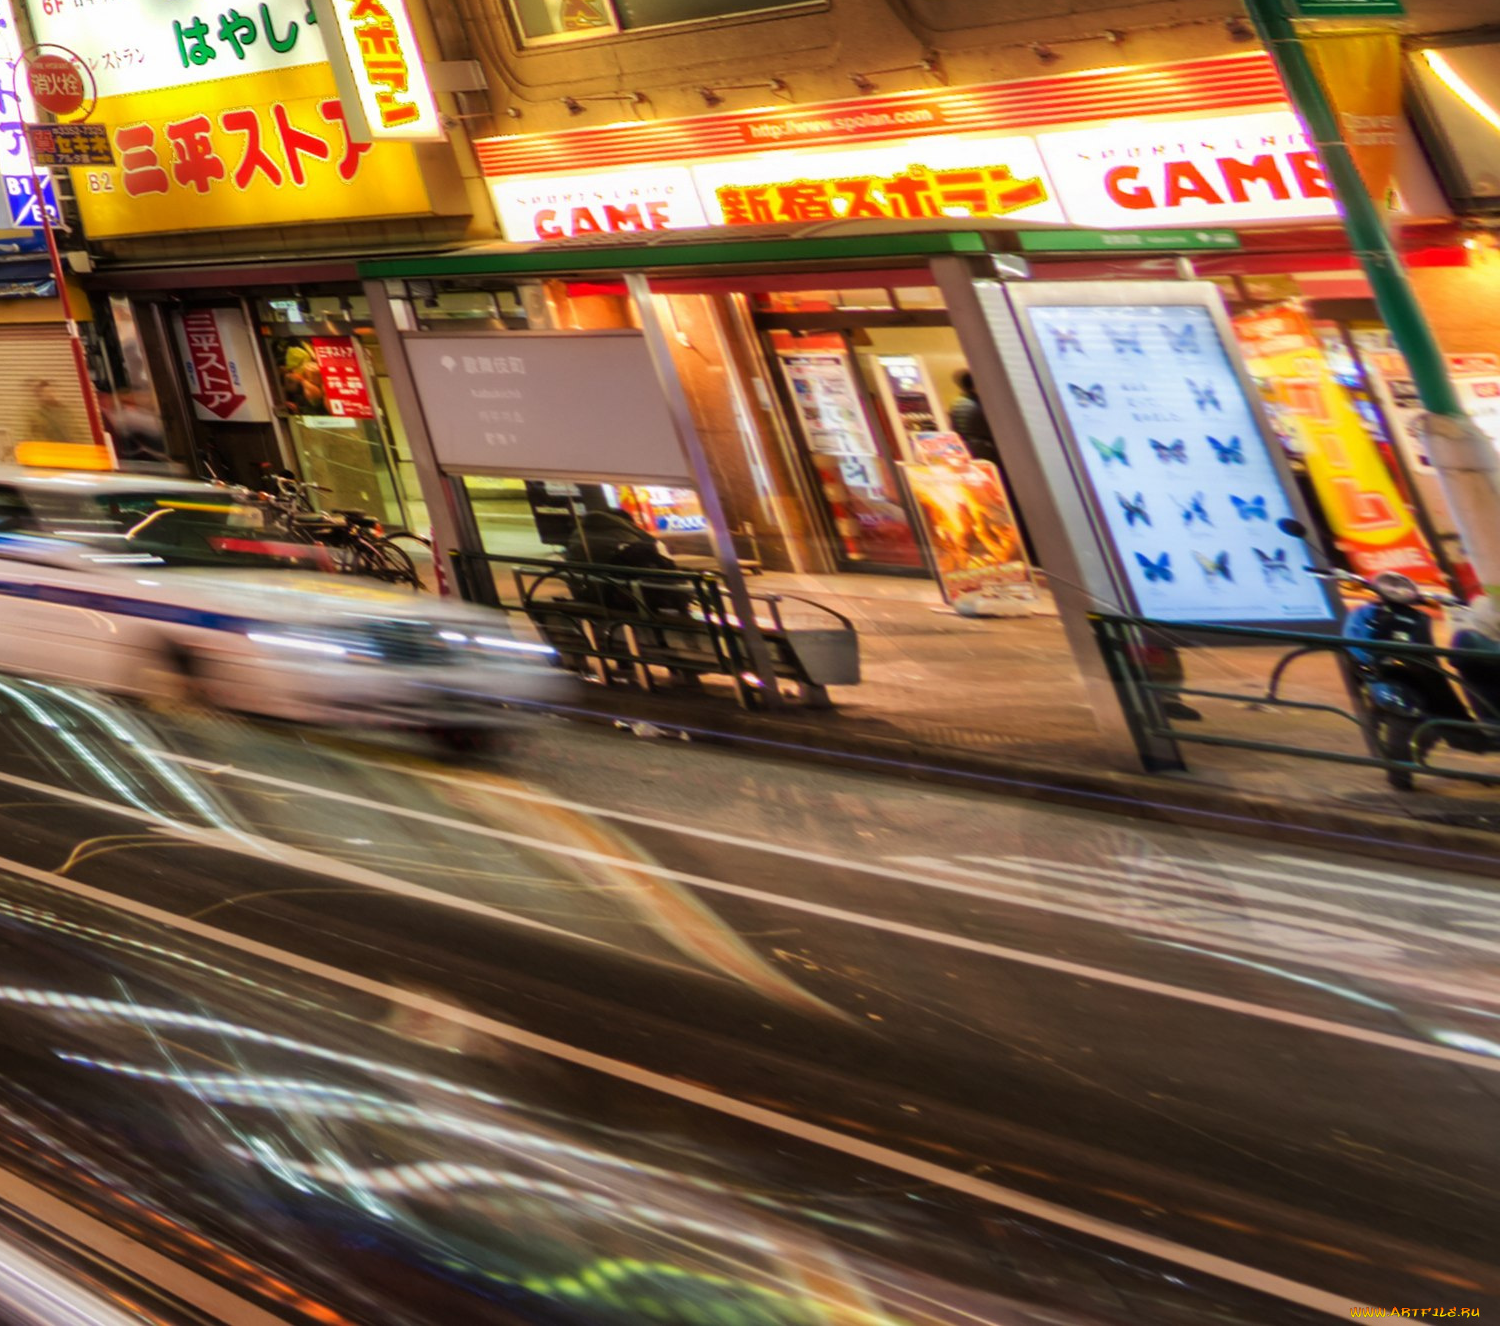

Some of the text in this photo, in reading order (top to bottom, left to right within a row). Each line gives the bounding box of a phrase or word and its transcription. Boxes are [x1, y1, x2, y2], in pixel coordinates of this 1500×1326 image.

[29, 71, 82, 98] 消火栓
[749, 104, 936, 140] http://www.spolan.com
[86, 171, 115, 193] B2
[714, 164, 1050, 226] 新宿スポラン
[1101, 149, 1335, 211] GAME
[533, 202, 675, 240] GAME
